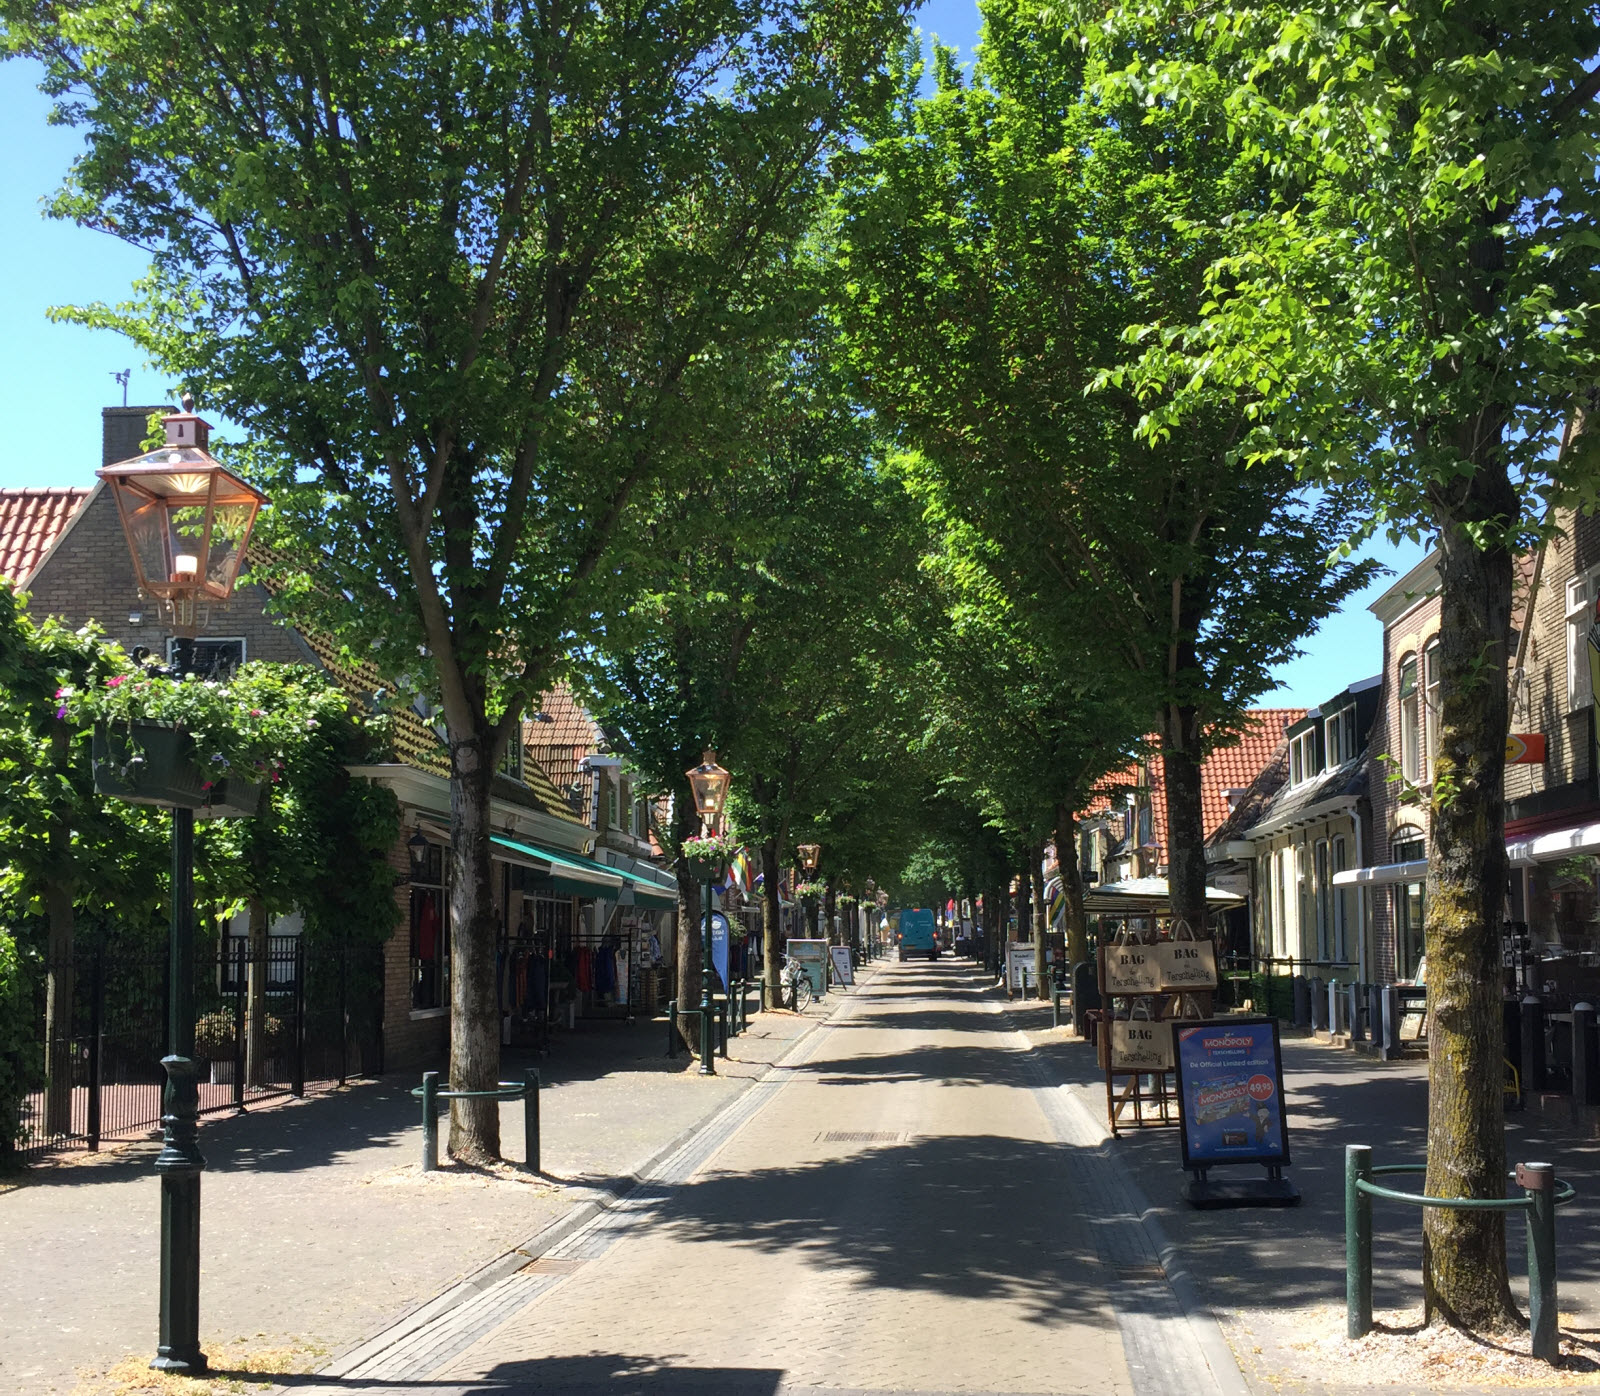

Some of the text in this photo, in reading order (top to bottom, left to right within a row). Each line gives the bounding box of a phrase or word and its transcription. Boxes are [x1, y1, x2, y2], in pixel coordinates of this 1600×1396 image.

[1120, 954, 1145, 965] BAG
[1174, 948, 1198, 960] BAG
[1166, 967, 1211, 982] Terschelling
[1111, 975, 1155, 988] Terschelling
[1128, 1029, 1153, 1040] BAG
[1204, 1037, 1252, 1048] MONOPOLY
[1119, 1050, 1163, 1066] Terschelling
[1199, 1060, 1222, 1068] Official
[1223, 1059, 1246, 1067] Limited
[1246, 1058, 1269, 1066] edition
[1249, 1083, 1272, 1094] 49,95
[1200, 1086, 1247, 1105] MONOPOLY
